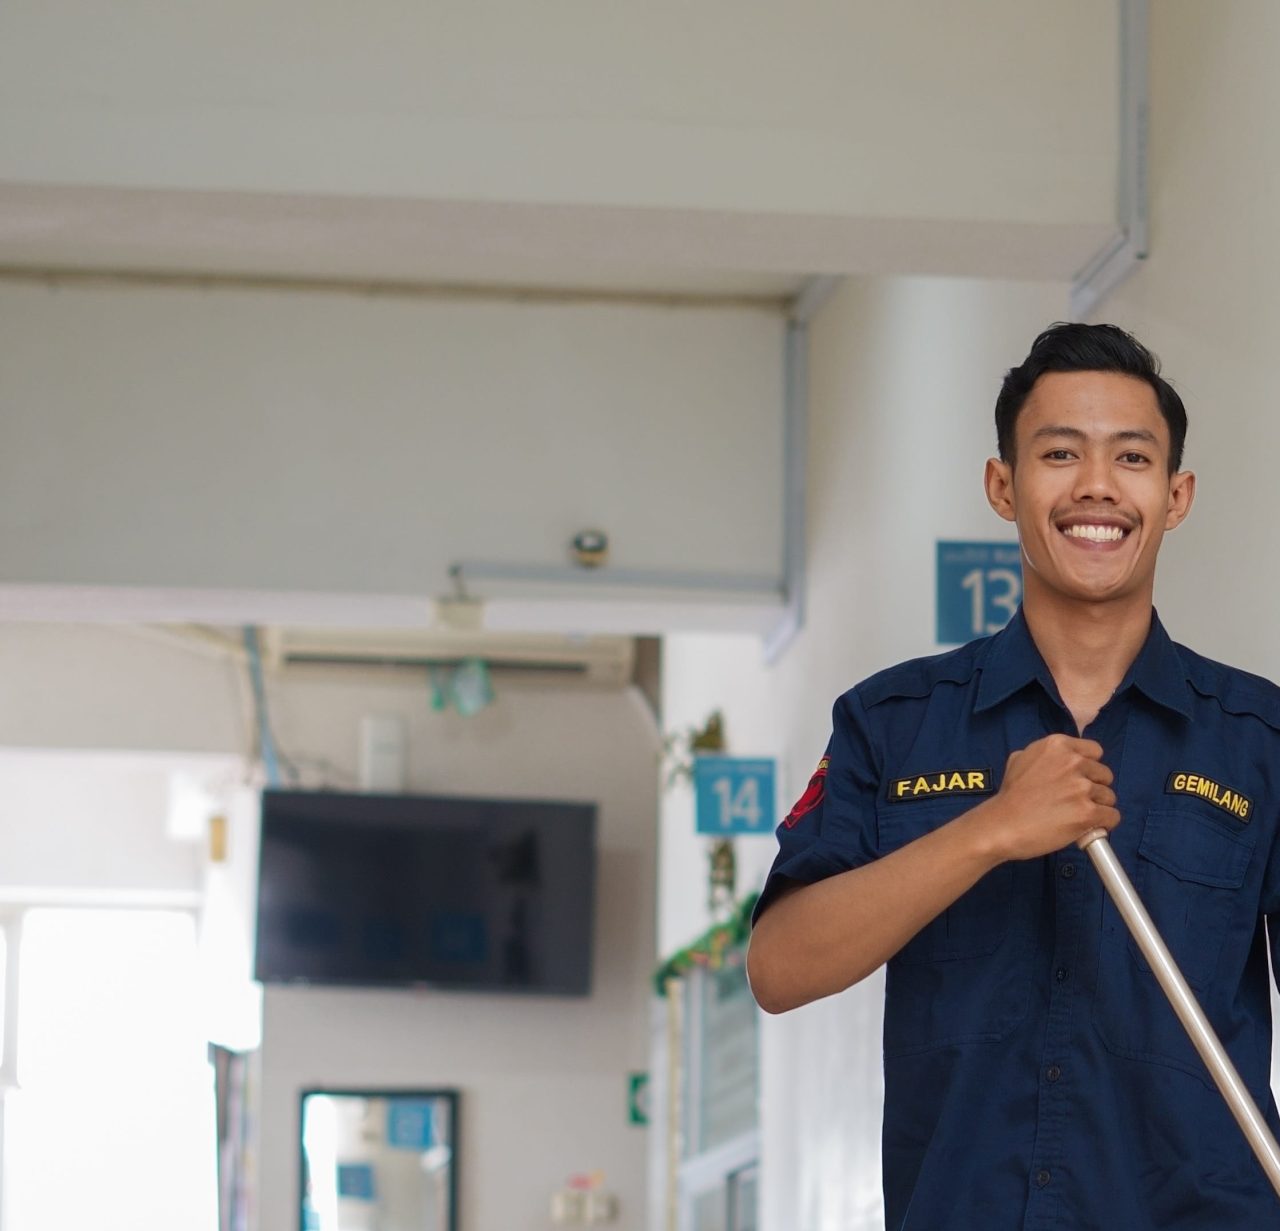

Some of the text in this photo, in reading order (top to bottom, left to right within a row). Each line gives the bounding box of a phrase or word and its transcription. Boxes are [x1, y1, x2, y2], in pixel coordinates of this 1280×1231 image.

[961, 568, 1021, 635] 13
[714, 777, 763, 829] 14
[897, 772, 985, 796] FAJAR
[1174, 774, 1249, 817] GEMILANG
